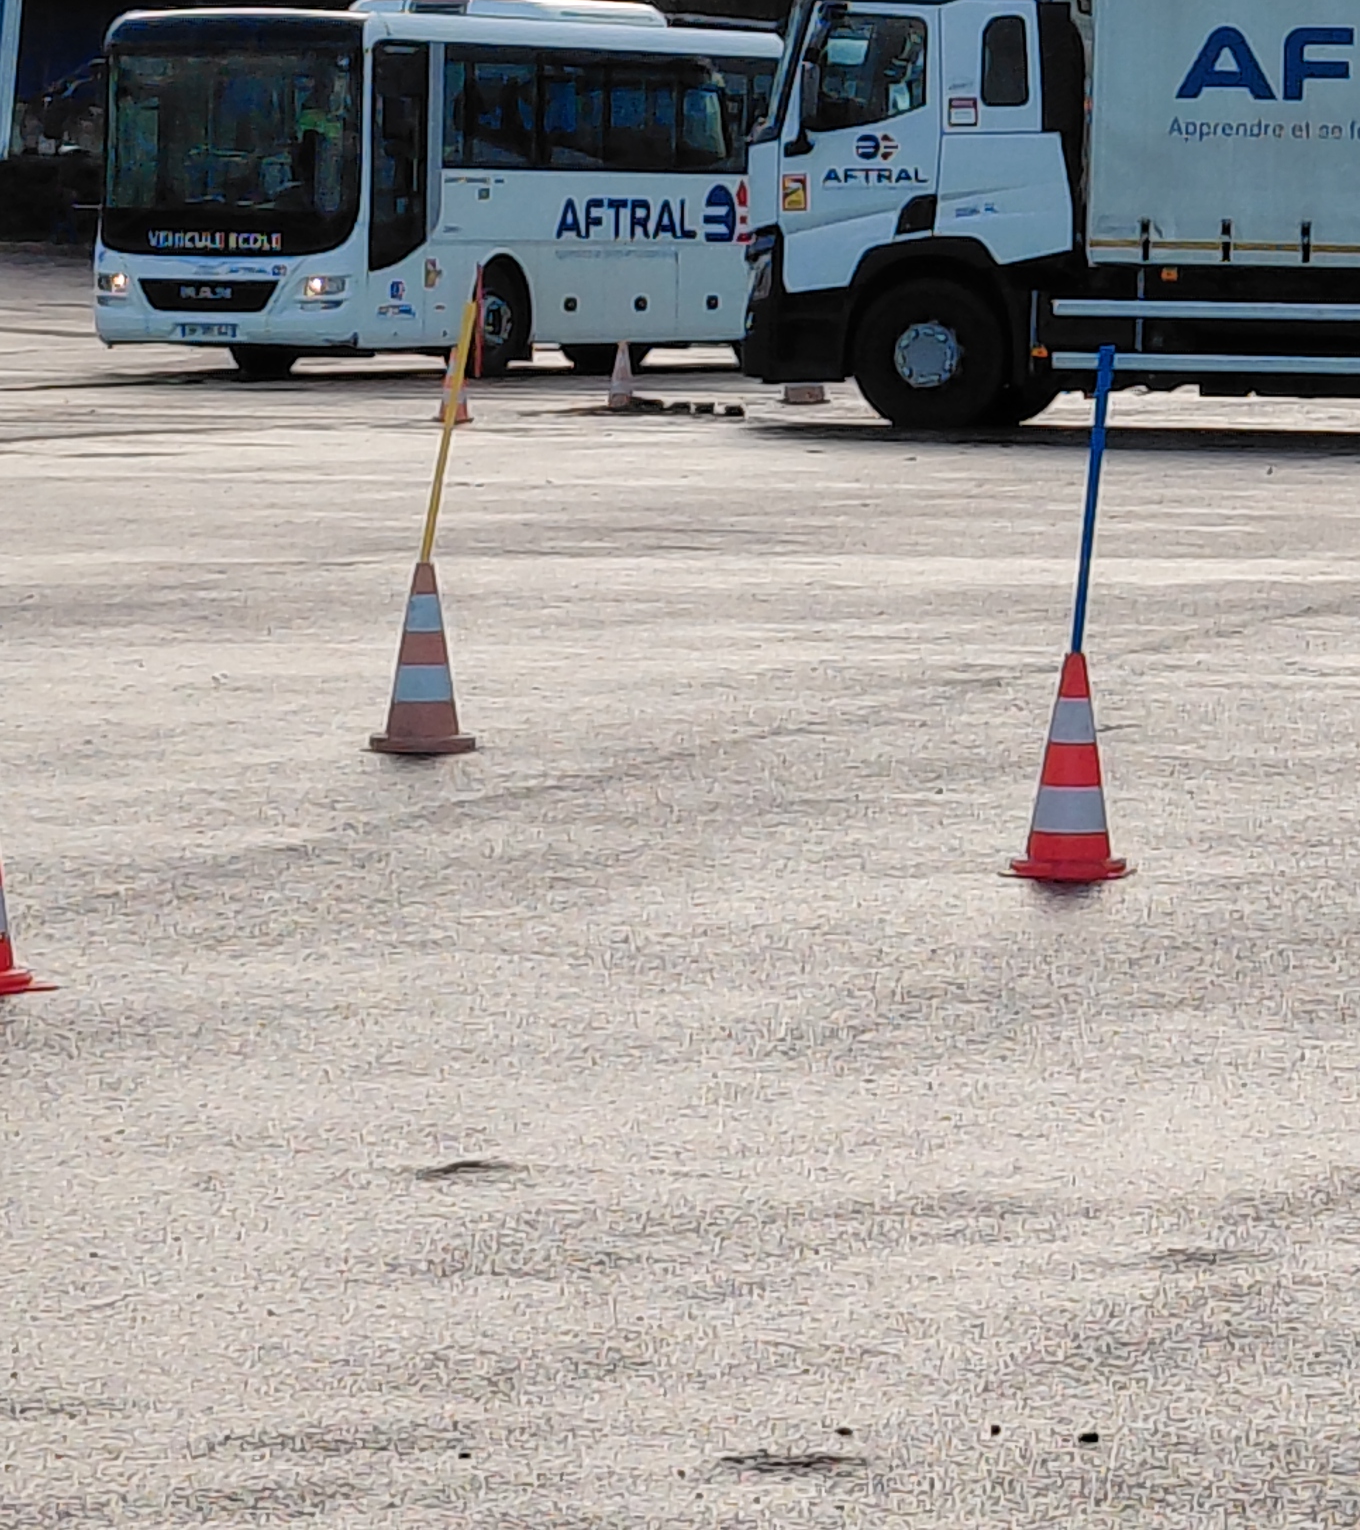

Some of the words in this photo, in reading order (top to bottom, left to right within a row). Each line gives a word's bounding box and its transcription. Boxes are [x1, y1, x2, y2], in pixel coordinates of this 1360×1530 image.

[1168, 116, 1285, 142] Apprendre
[1291, 120, 1311, 139] et
[823, 167, 928, 184] AFTRAL
[556, 198, 697, 239] AFTRAL
